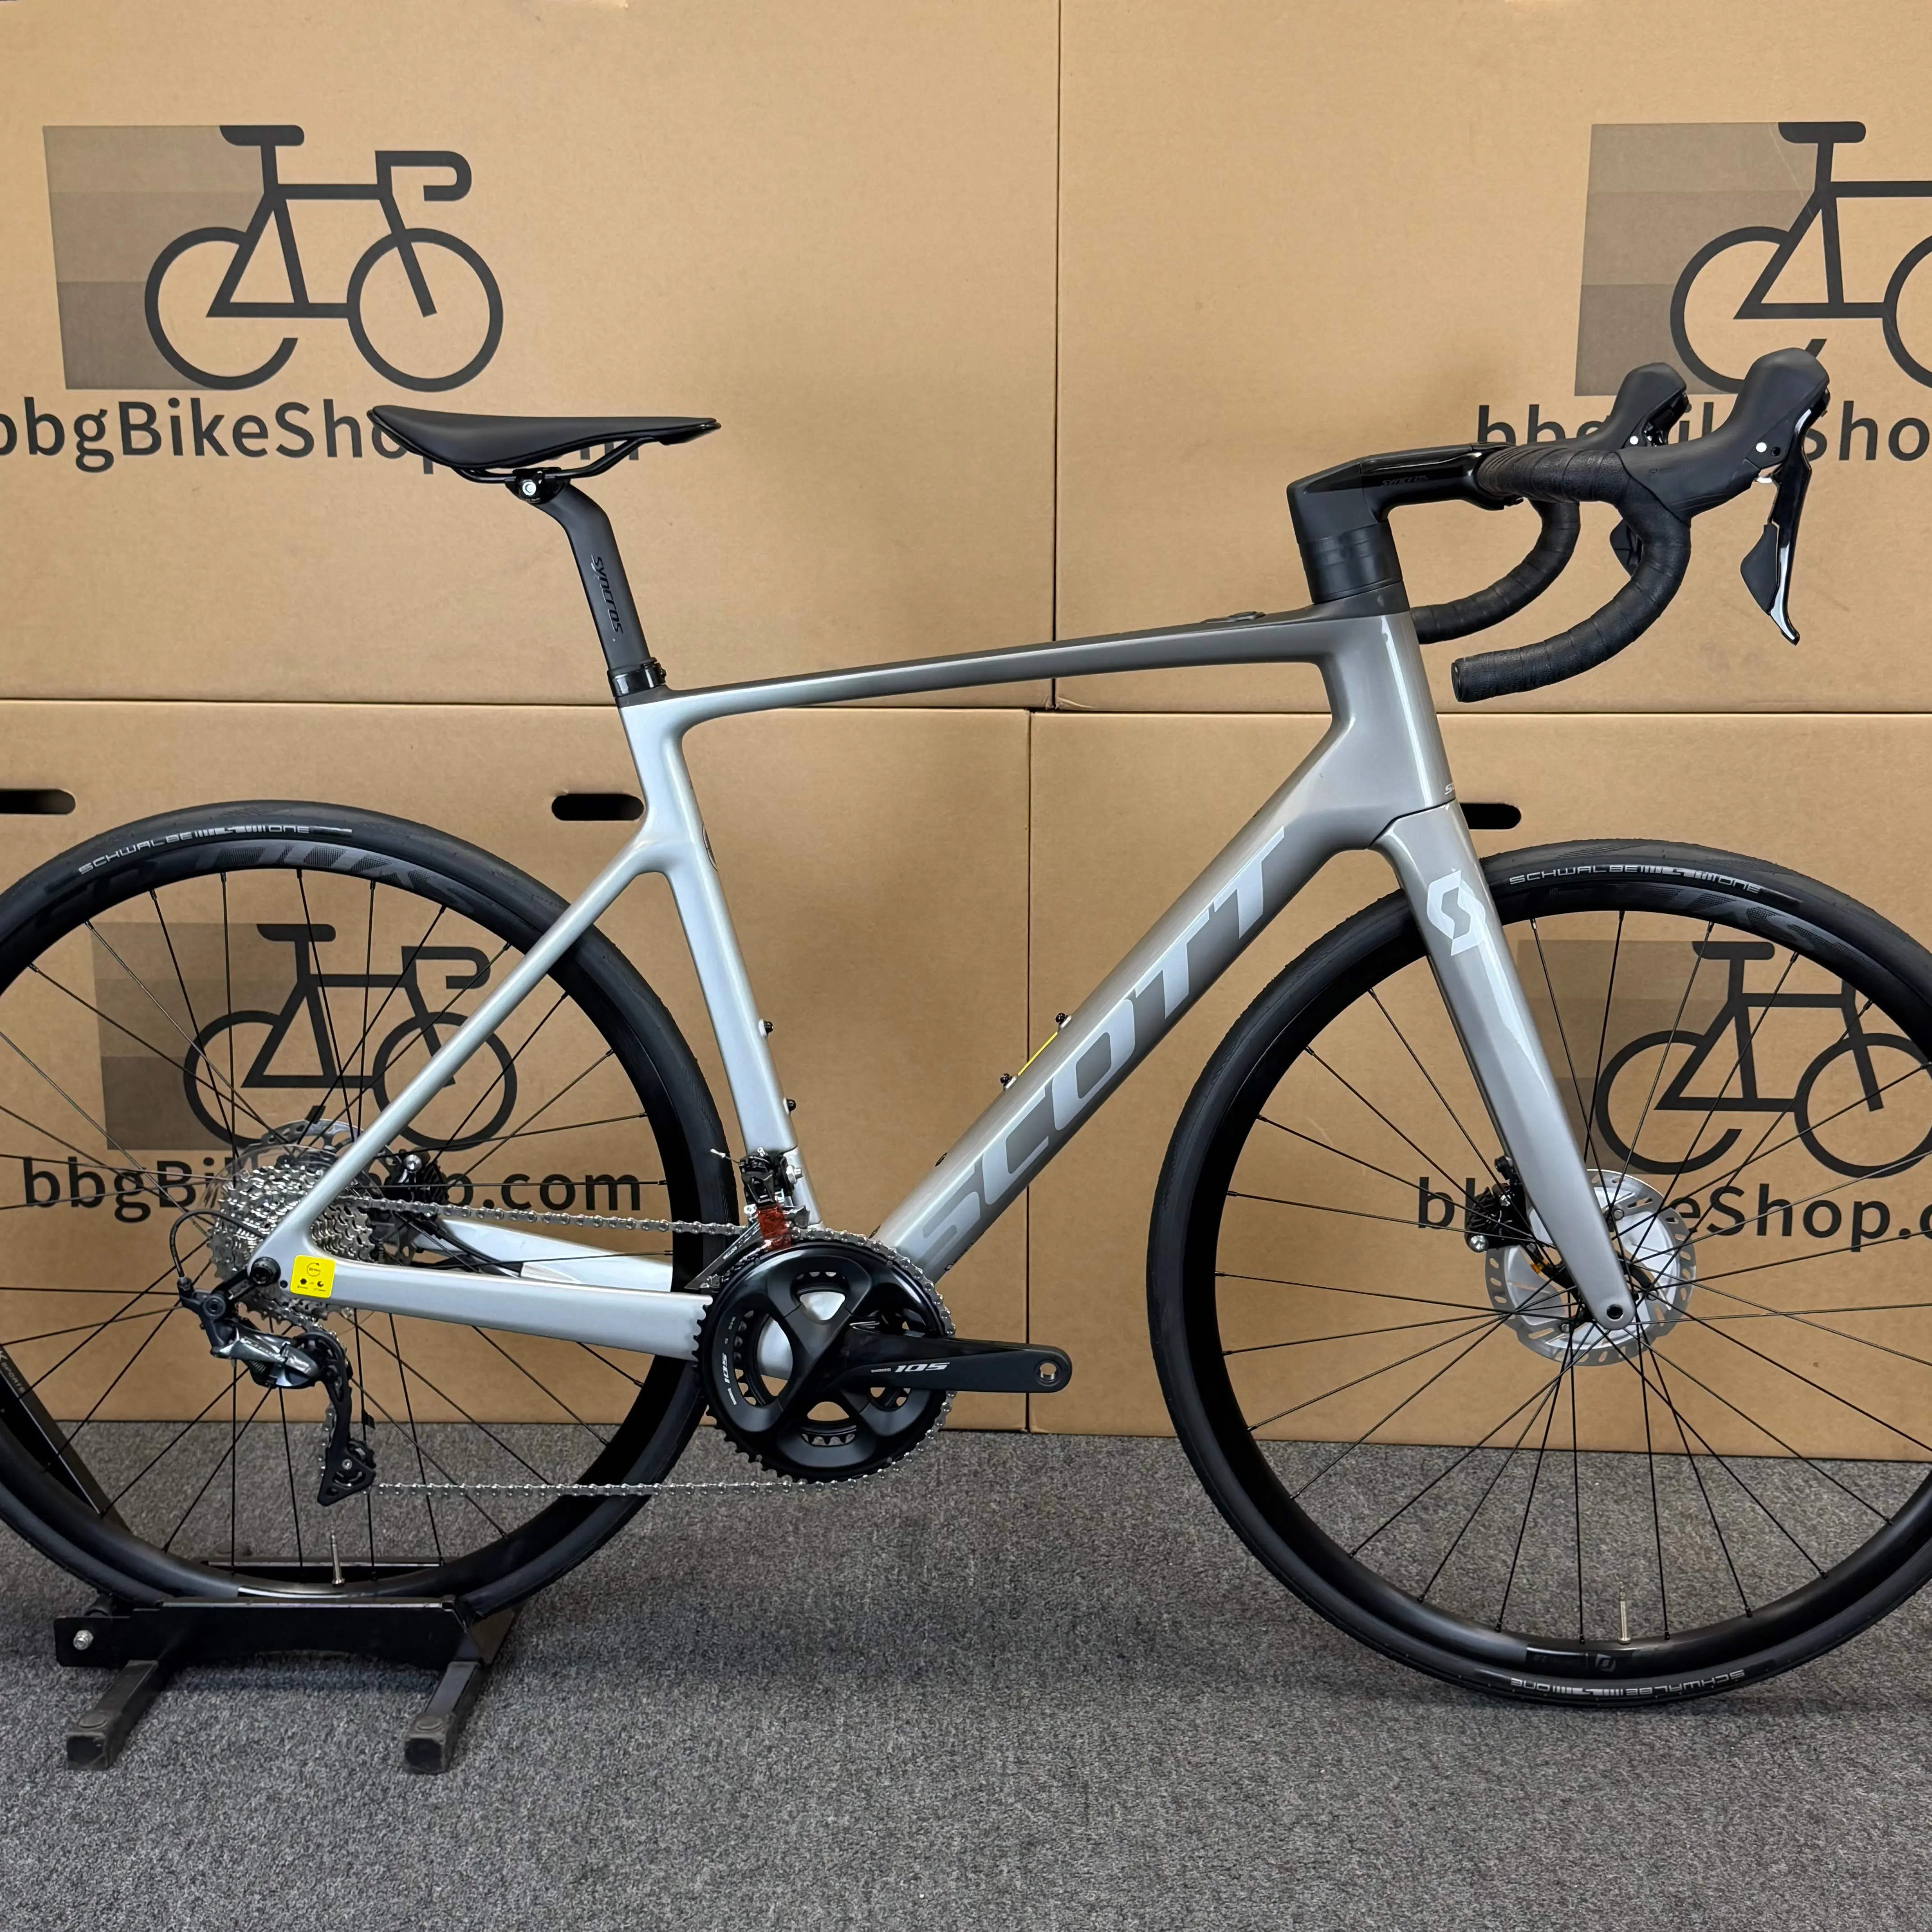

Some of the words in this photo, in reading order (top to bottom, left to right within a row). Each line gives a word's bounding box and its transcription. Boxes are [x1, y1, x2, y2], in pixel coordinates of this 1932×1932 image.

[78, 830, 193, 875] SCHWALBE
[269, 825, 310, 834] ONE
[1509, 865, 1638, 885] SCHWALBE
[1719, 874, 1761, 894] ONE
[894, 826, 1284, 1270] SCOTT
[895, 1362, 950, 1373] 105
[1625, 1669, 1745, 1696] SCHWALBE
